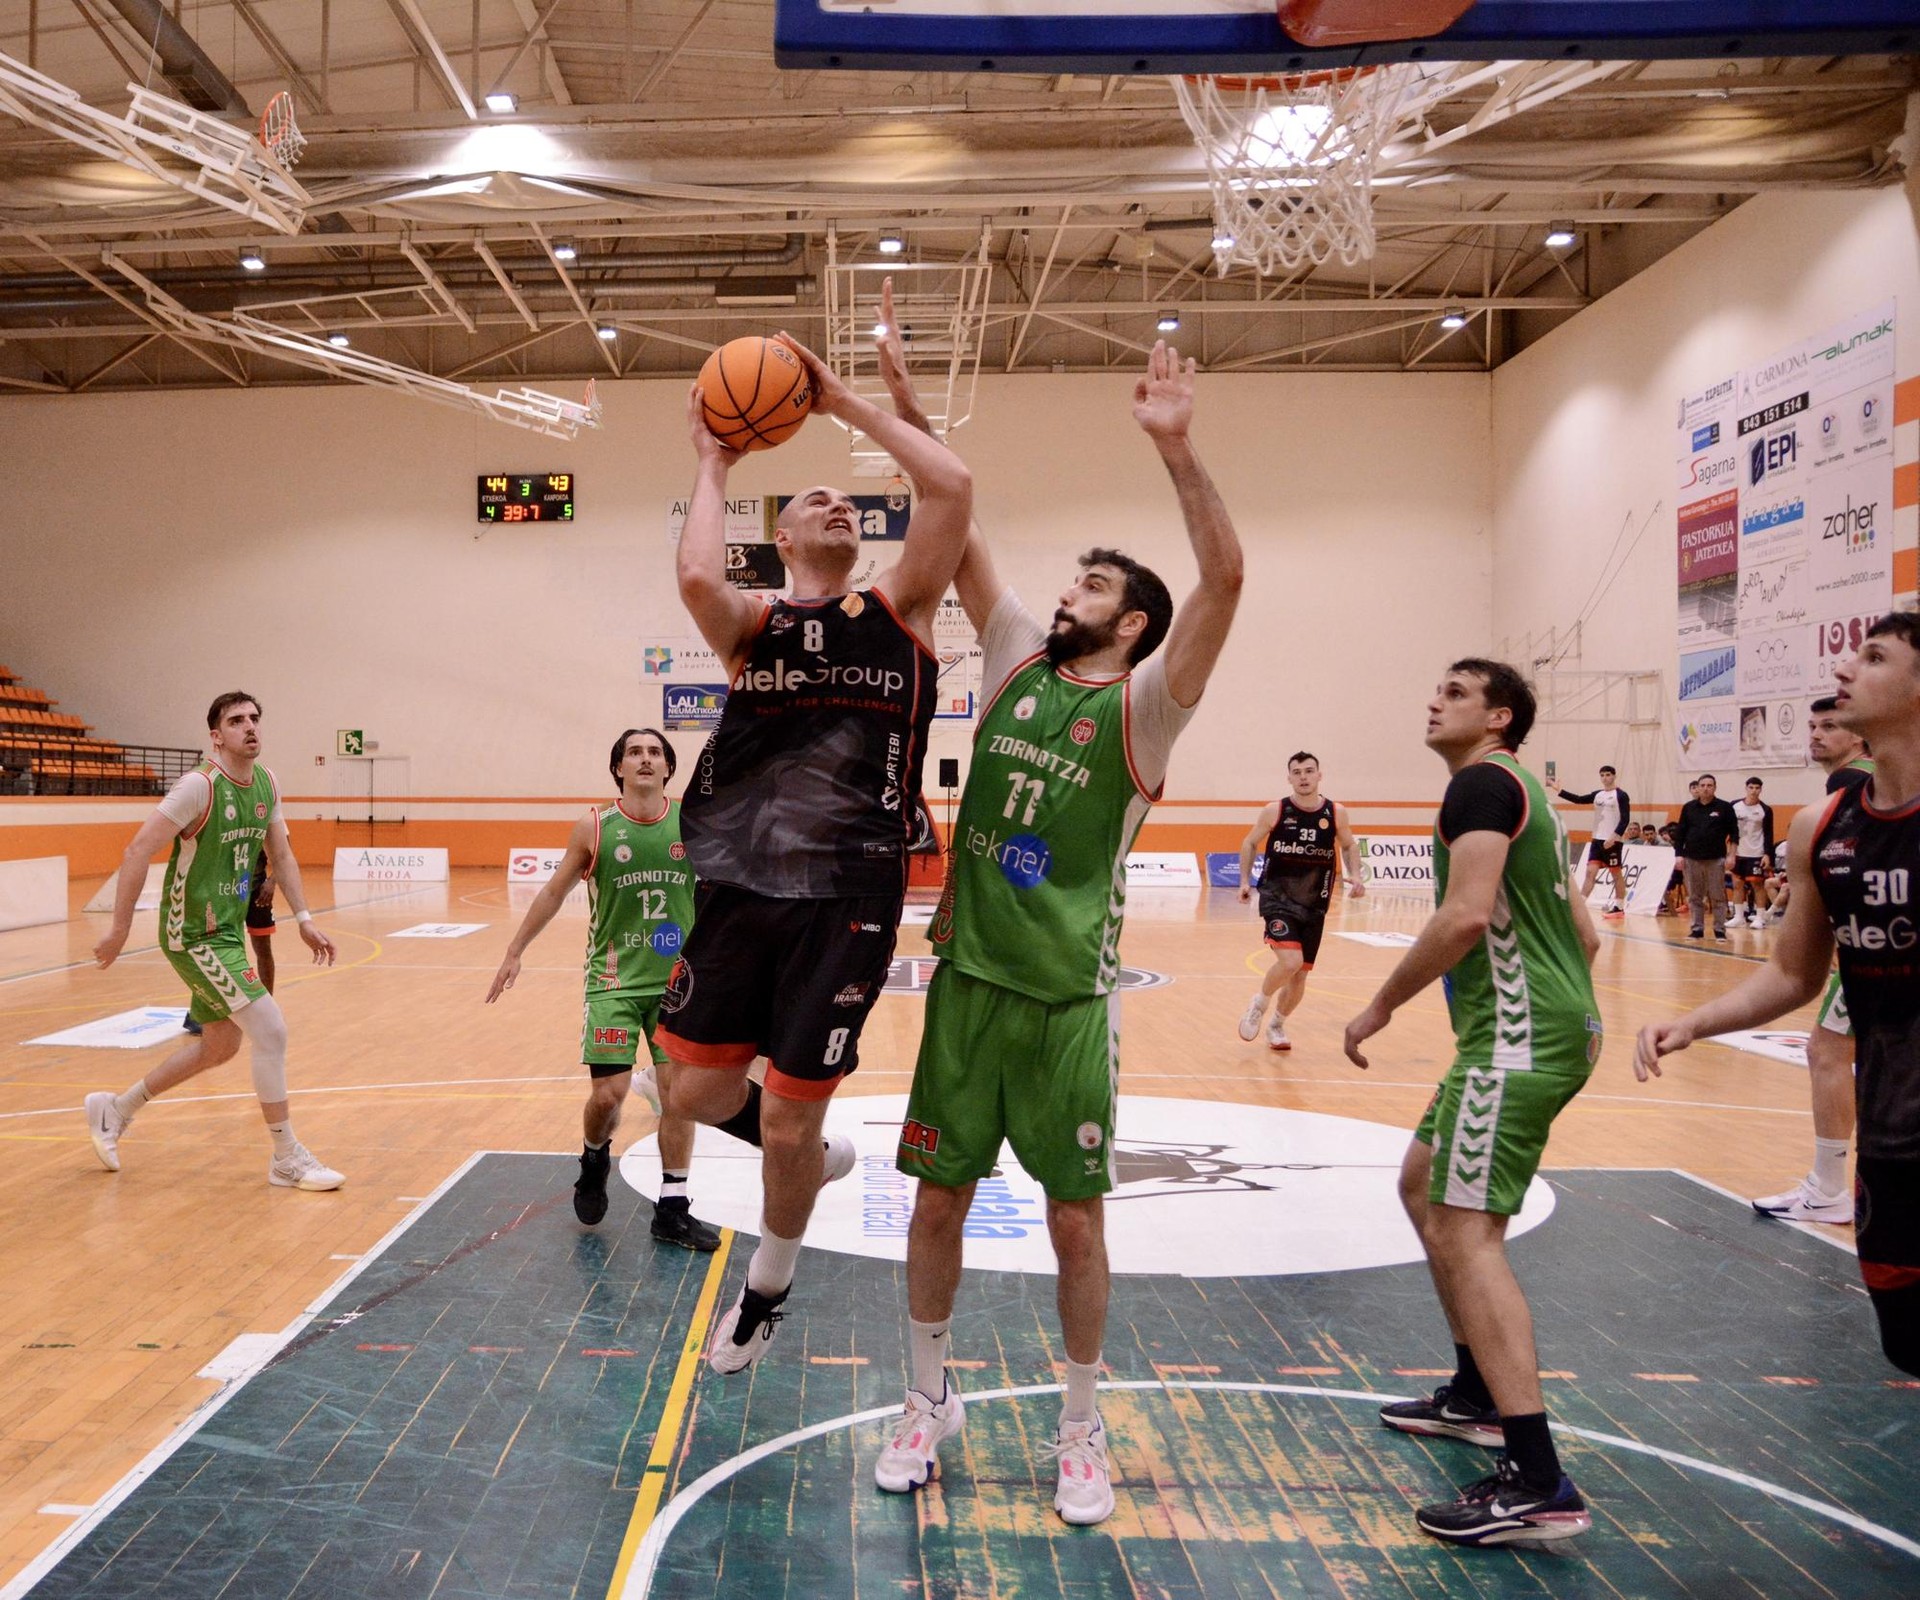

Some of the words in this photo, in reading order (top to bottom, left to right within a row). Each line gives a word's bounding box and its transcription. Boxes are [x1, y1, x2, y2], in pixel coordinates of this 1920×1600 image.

[1812, 319, 1893, 360] alumak
[1743, 415, 1761, 433] 943
[1764, 407, 1780, 423] 151
[1783, 397, 1802, 415] 514
[1768, 431, 1797, 471] EPI
[548, 475, 570, 491] 43
[1680, 456, 1735, 489] Sagarna
[487, 477, 507, 492] 44
[522, 483, 530, 496] 3
[486, 506, 495, 517] 4
[564, 503, 572, 517] 5
[1822, 495, 1878, 546] zaher
[1681, 520, 1735, 549] PASTORKUA
[1694, 540, 1735, 563] JATETXEA
[804, 619, 824, 652] 8
[668, 695, 698, 708] LAU
[988, 734, 1091, 789] ZORNOTZA
[1002, 771, 1046, 827] 11
[1300, 828, 1317, 842] 33
[966, 823, 1050, 877] teknei
[1273, 840, 1335, 859] BieleGroup
[1357, 838, 1434, 858] ONTAJE
[367, 870, 412, 879] RIOJA
[613, 870, 688, 889] ZORNOTZA
[1374, 865, 1434, 880] LAIZOL
[1862, 868, 1909, 906] 30
[636, 889, 668, 920] 12
[623, 928, 681, 947] teknei
[861, 923, 881, 932] WIBO
[822, 1027, 849, 1066] 8
